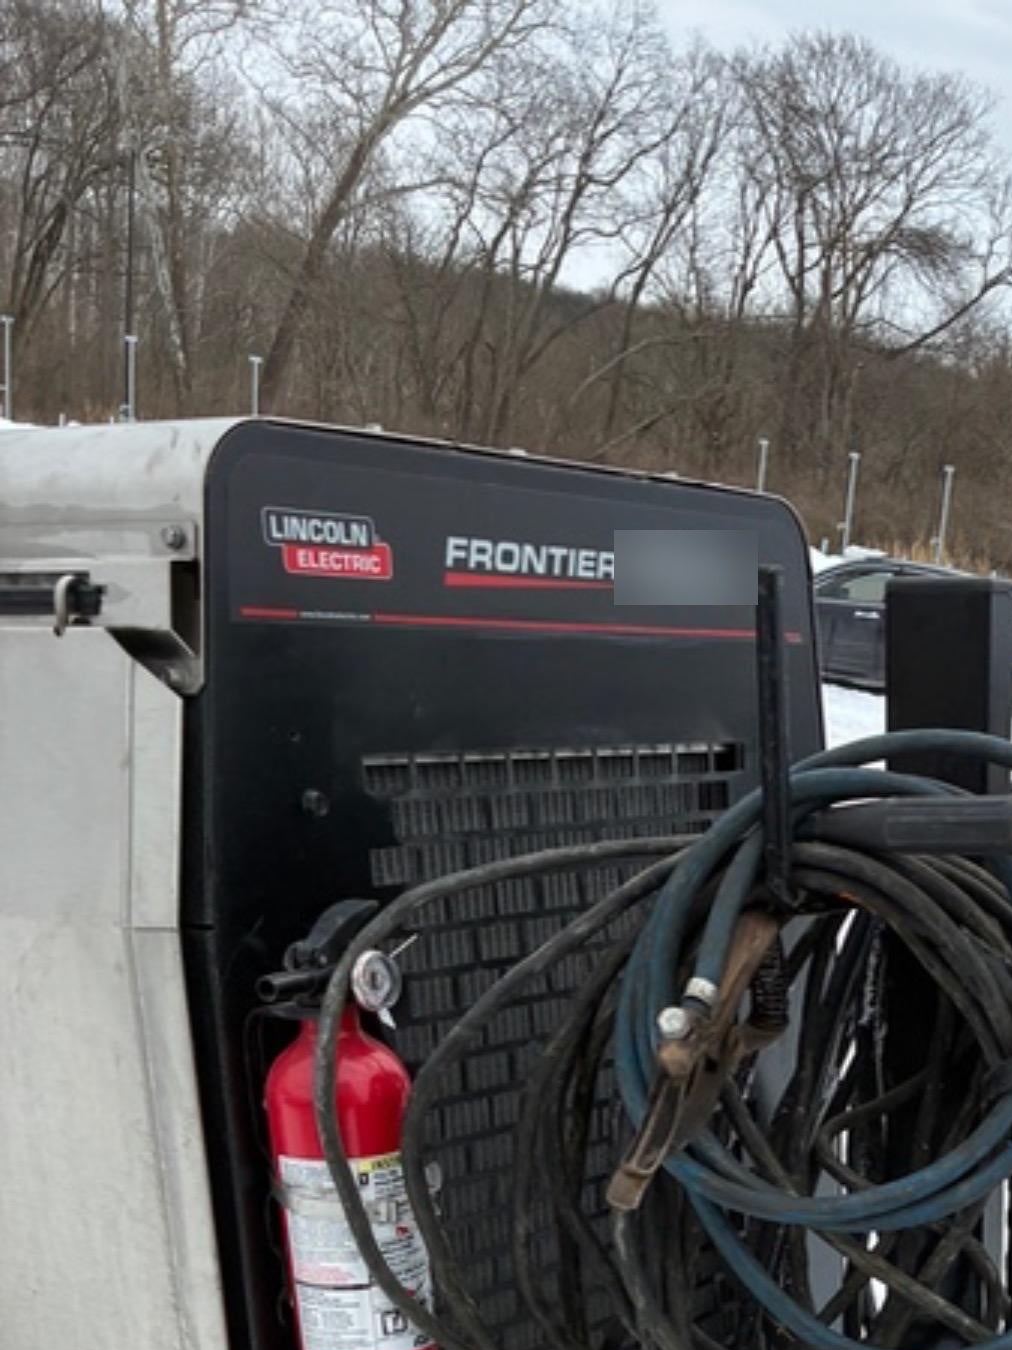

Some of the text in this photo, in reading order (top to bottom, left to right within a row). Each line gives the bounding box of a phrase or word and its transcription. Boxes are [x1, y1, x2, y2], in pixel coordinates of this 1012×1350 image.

[269, 514, 369, 547] LINCOLN
[296, 548, 381, 574] ELECTRIC
[445, 535, 614, 580] FRONTIER
